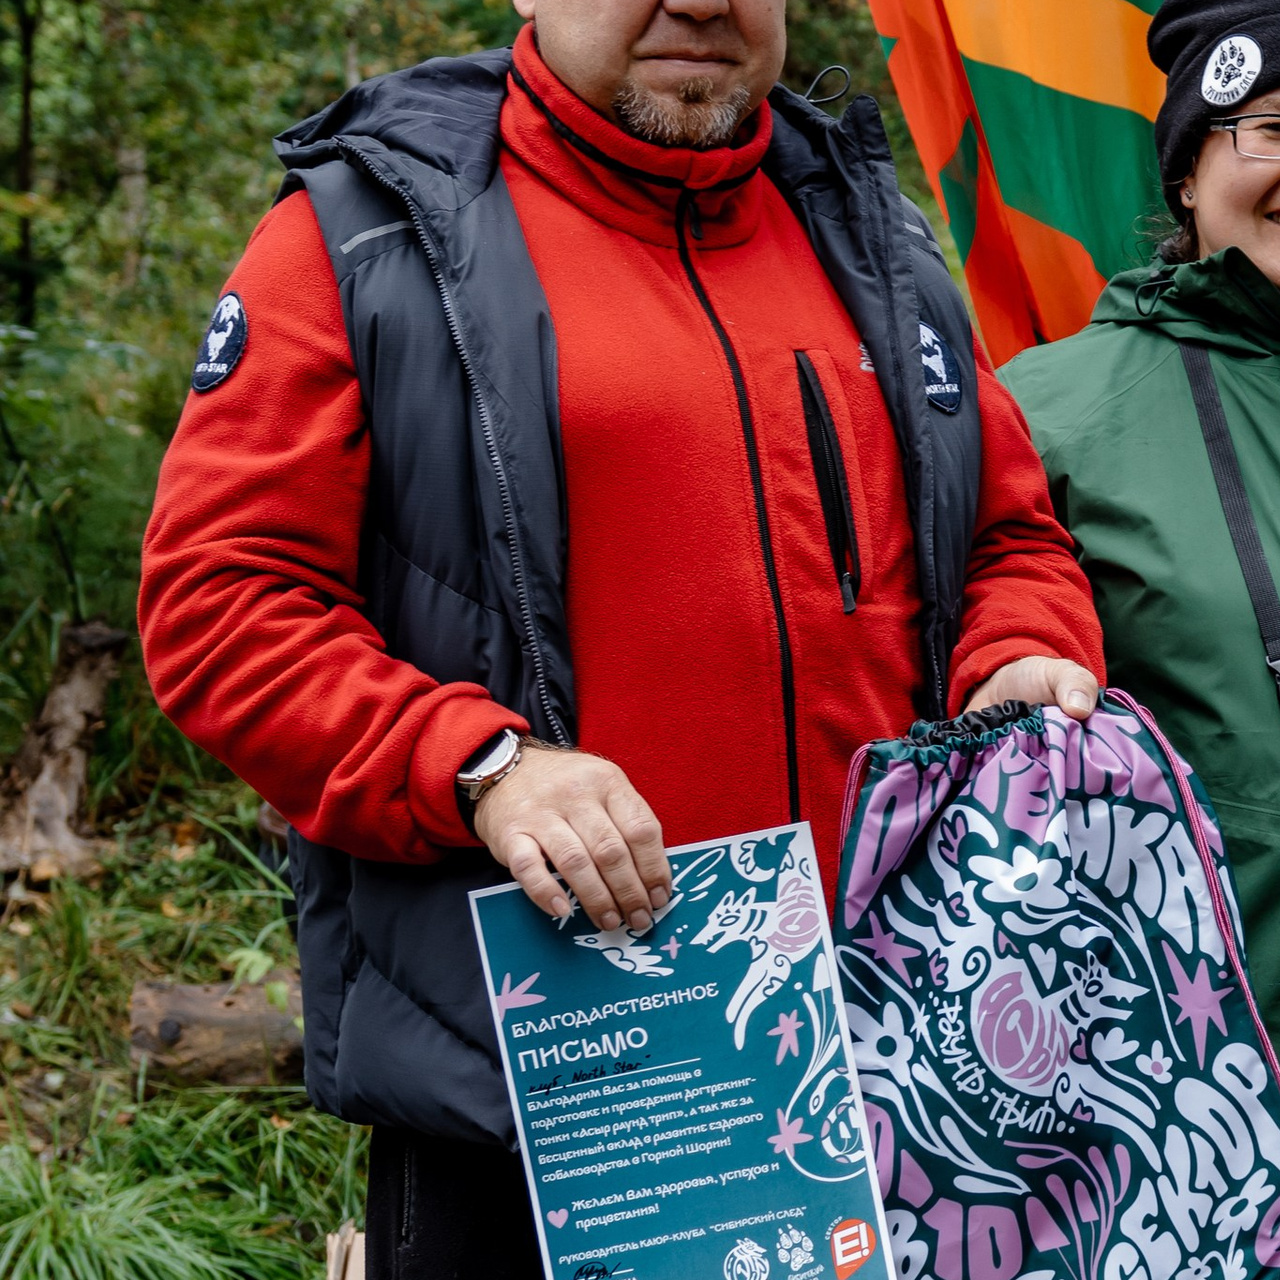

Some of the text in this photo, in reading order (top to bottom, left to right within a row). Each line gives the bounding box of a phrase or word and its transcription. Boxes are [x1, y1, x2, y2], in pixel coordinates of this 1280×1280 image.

[510, 981, 719, 1038] БЛАГОДАРСТВЕННОЕ
[516, 1026, 649, 1072] ПИСЬМО
[525, 1067, 702, 1112] Благодарим Вас за помощь в
[529, 1076, 757, 1130] подготовке и проведении догтрекинг-
[533, 1132, 570, 1147] гонки
[611, 1115, 649, 1136] раунд
[688, 1106, 698, 1116] а
[696, 1101, 720, 1114] так
[719, 1097, 739, 1110] же
[738, 1095, 754, 1106] за
[537, 1111, 764, 1165] бесценный вклад в развитие ездового
[540, 1135, 732, 1183] собаководства в Горной Шории!
[570, 1161, 780, 1212] Желаем Вам здоровья, успехов и
[574, 1202, 660, 1233] процветания!
[557, 1241, 640, 1265] РУКОВОДИТЕЛЬ
[638, 1227, 707, 1248] КАЮР-КЛУБА
